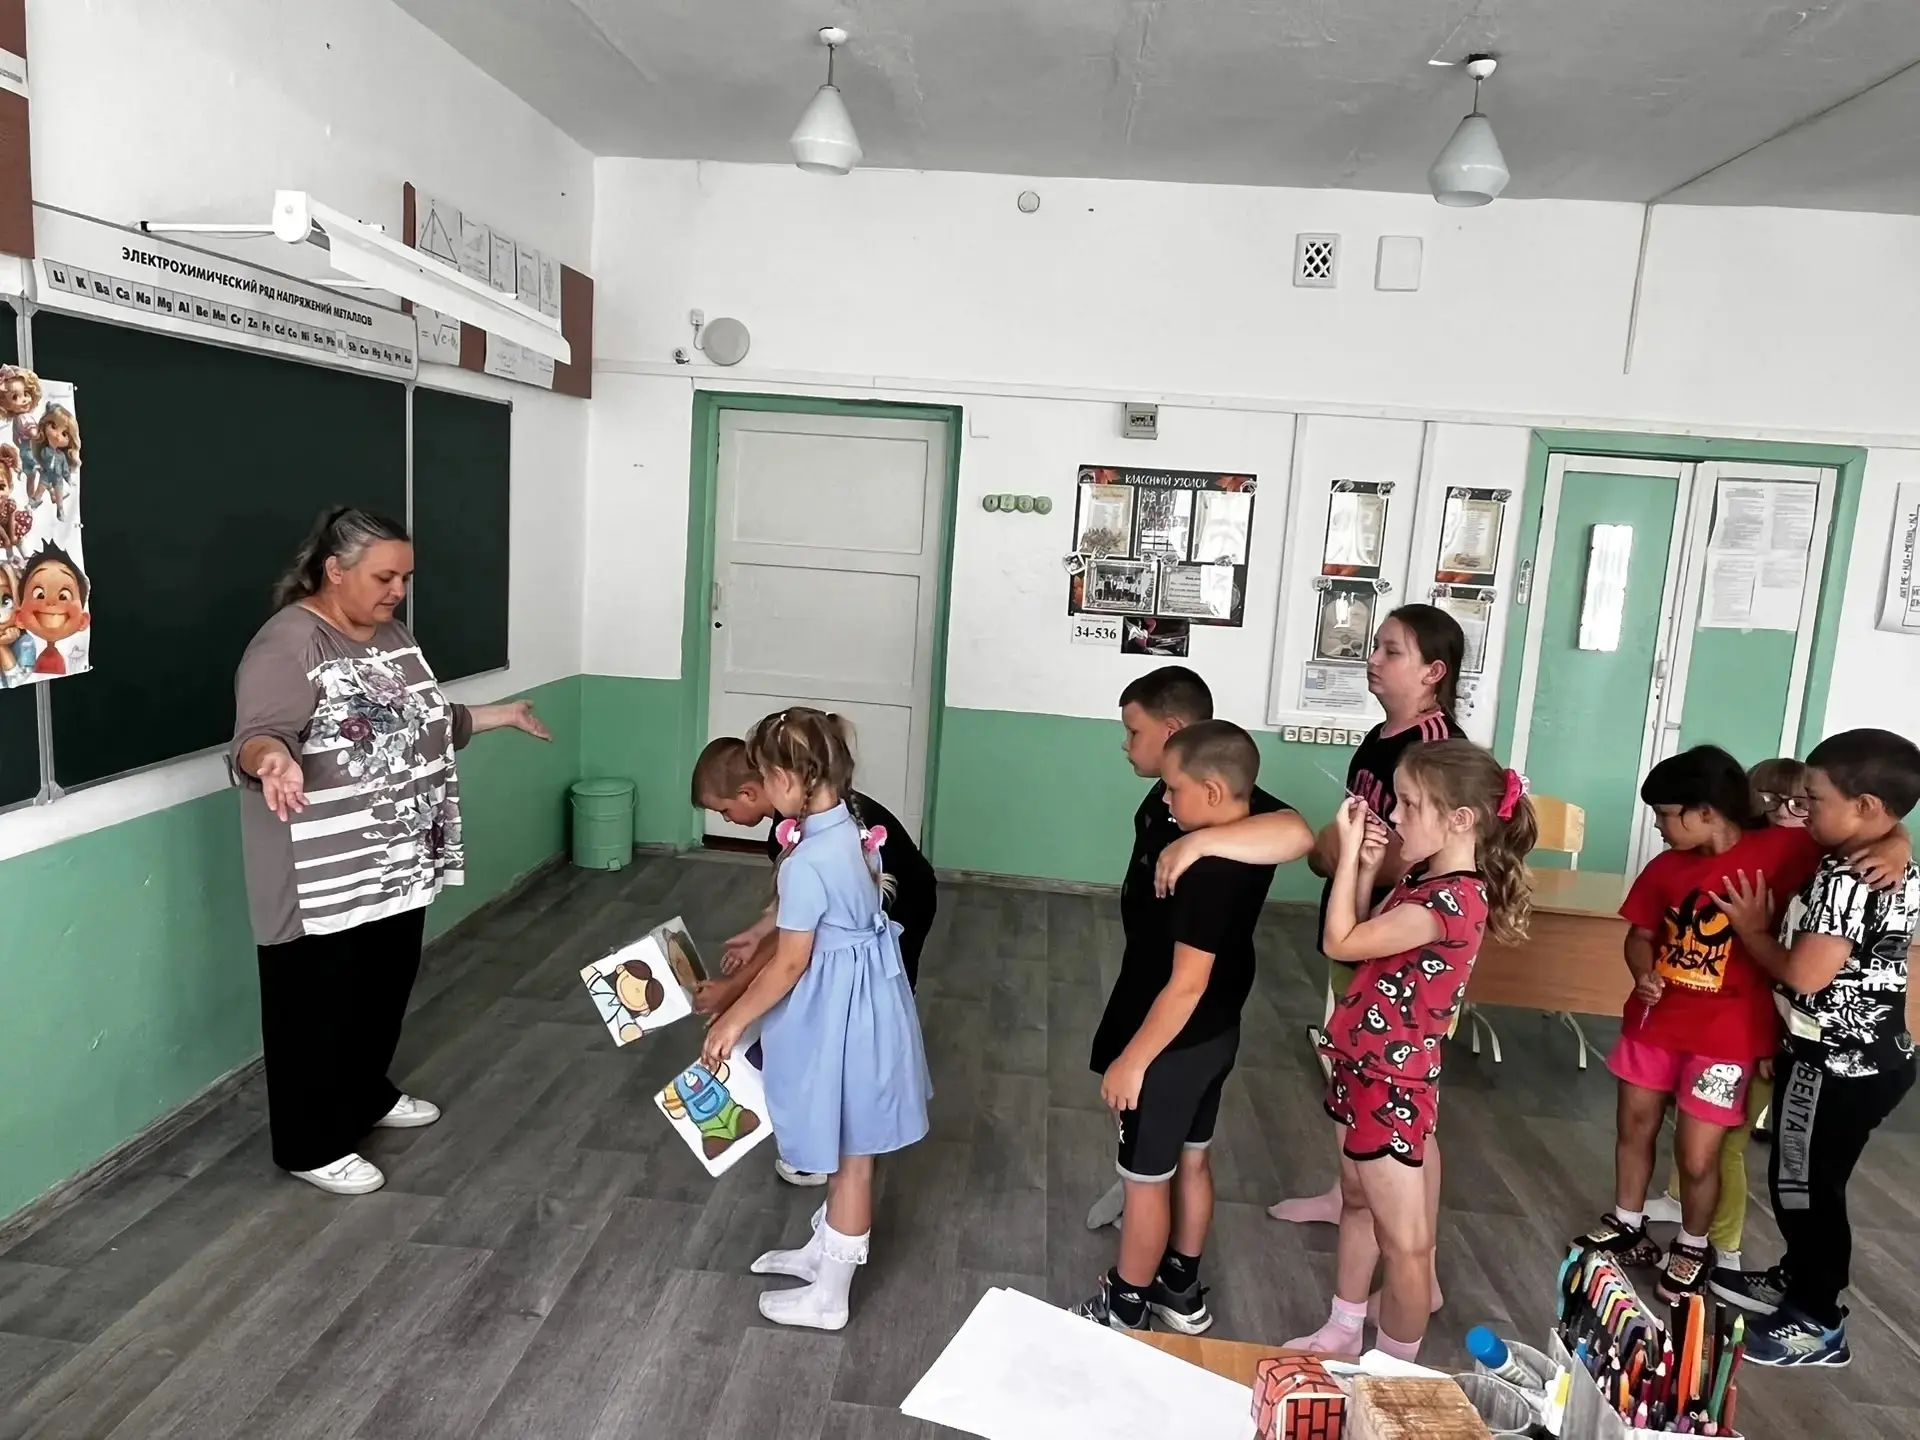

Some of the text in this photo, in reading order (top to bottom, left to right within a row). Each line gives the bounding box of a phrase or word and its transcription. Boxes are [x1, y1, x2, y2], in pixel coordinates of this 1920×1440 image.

[122, 247, 373, 326] ЭЛЕКТРОХИМИЧЕСКИЙ РЯД НАПРЯЖЕНИЙ МЕТАЛЛОВ
[53, 270, 66, 284] Li
[94, 281, 110, 296] Ba
[116, 287, 130, 300] Ca
[136, 291, 151, 305] Na
[157, 296, 172, 312] Mg
[178, 302, 190, 313] Al
[195, 305, 209, 318] Be
[212, 308, 226, 321] Mn
[230, 313, 242, 325] Cr
[247, 317, 258, 329] Zn
[262, 321, 271, 332] Fe
[274, 324, 285, 335] Cd
[288, 328, 297, 338] Co
[301, 331, 310, 342] Ni
[313, 333, 323, 344] Sn
[326, 336, 335, 347] Pb
[348, 342, 357, 351] Sb
[360, 345, 369, 355] Cu
[371, 347, 381, 359] Hg
[383, 350, 392, 361] Ag
[394, 352, 402, 361] Pt
[1125, 473, 1209, 489] КЛАССНЫЙ УГОЛОК
[1074, 625, 1118, 640] 34-536
